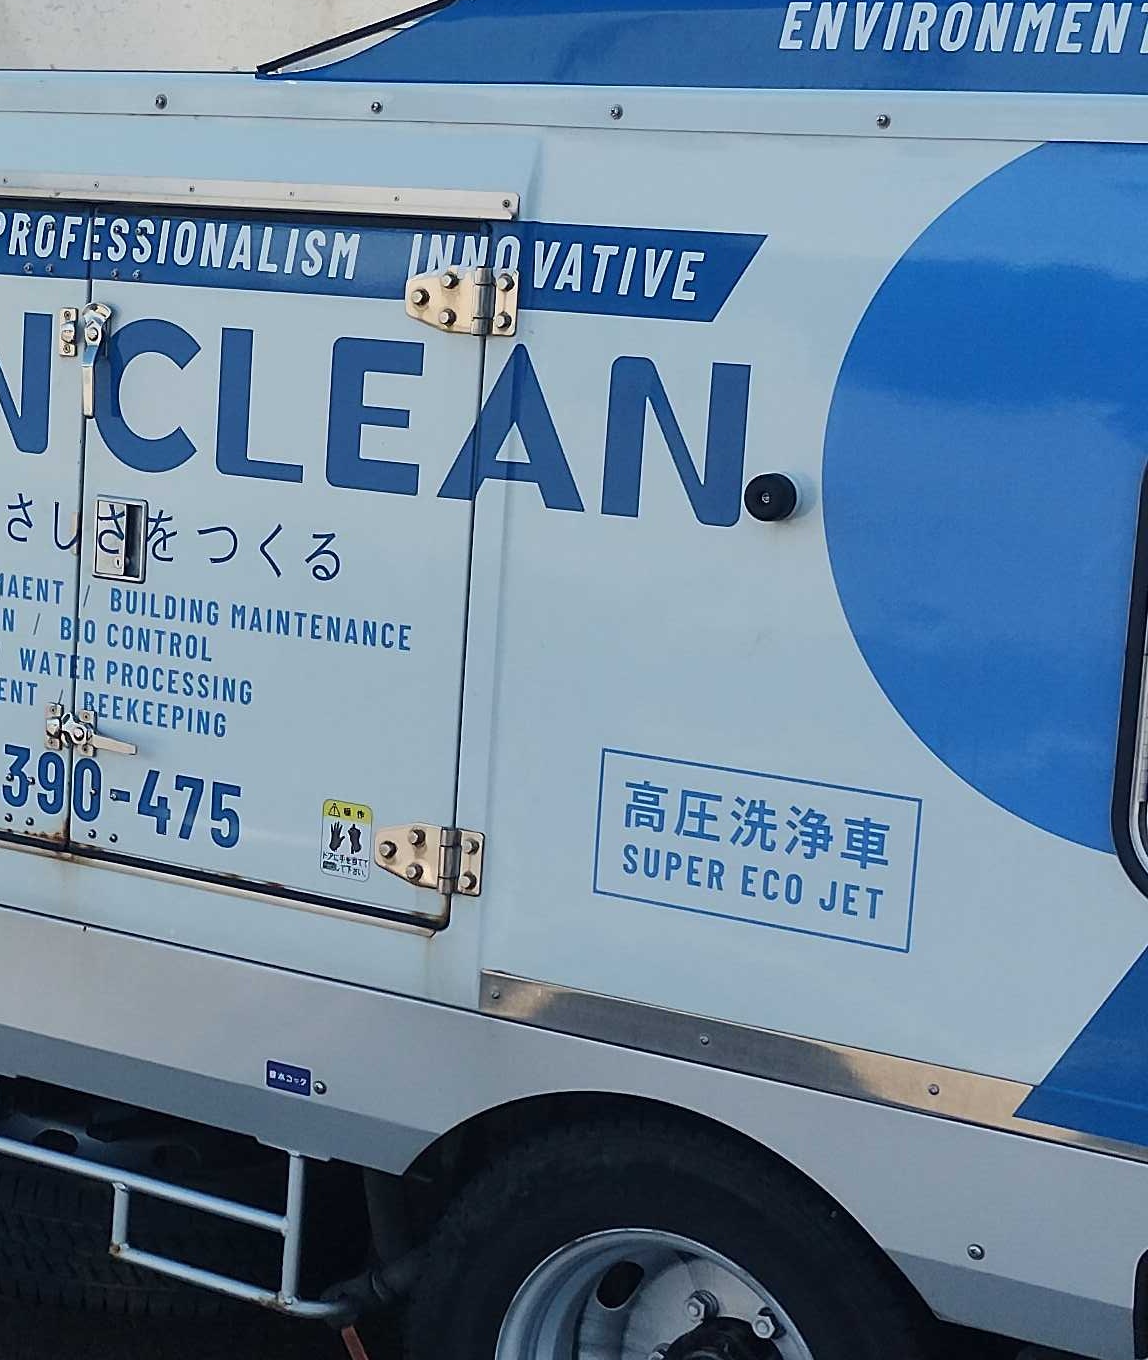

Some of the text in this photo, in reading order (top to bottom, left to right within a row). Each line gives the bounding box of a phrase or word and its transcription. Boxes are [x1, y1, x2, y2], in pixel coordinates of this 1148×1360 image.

[407, 232, 705, 302] INNOVATIVE
[60, 616, 97, 644] BIO
[107, 623, 212, 663] CONTROL
[110, 587, 220, 627] BUILDING
[231, 604, 412, 651] MAINTENANCE
[19, 647, 97, 681] WATER
[106, 660, 253, 706] PROCESSING
[83, 691, 227, 738] BEEKEEPING
[624, 780, 891, 871] 高圧洗浄車
[623, 844, 884, 920] SUPER ECO JET
